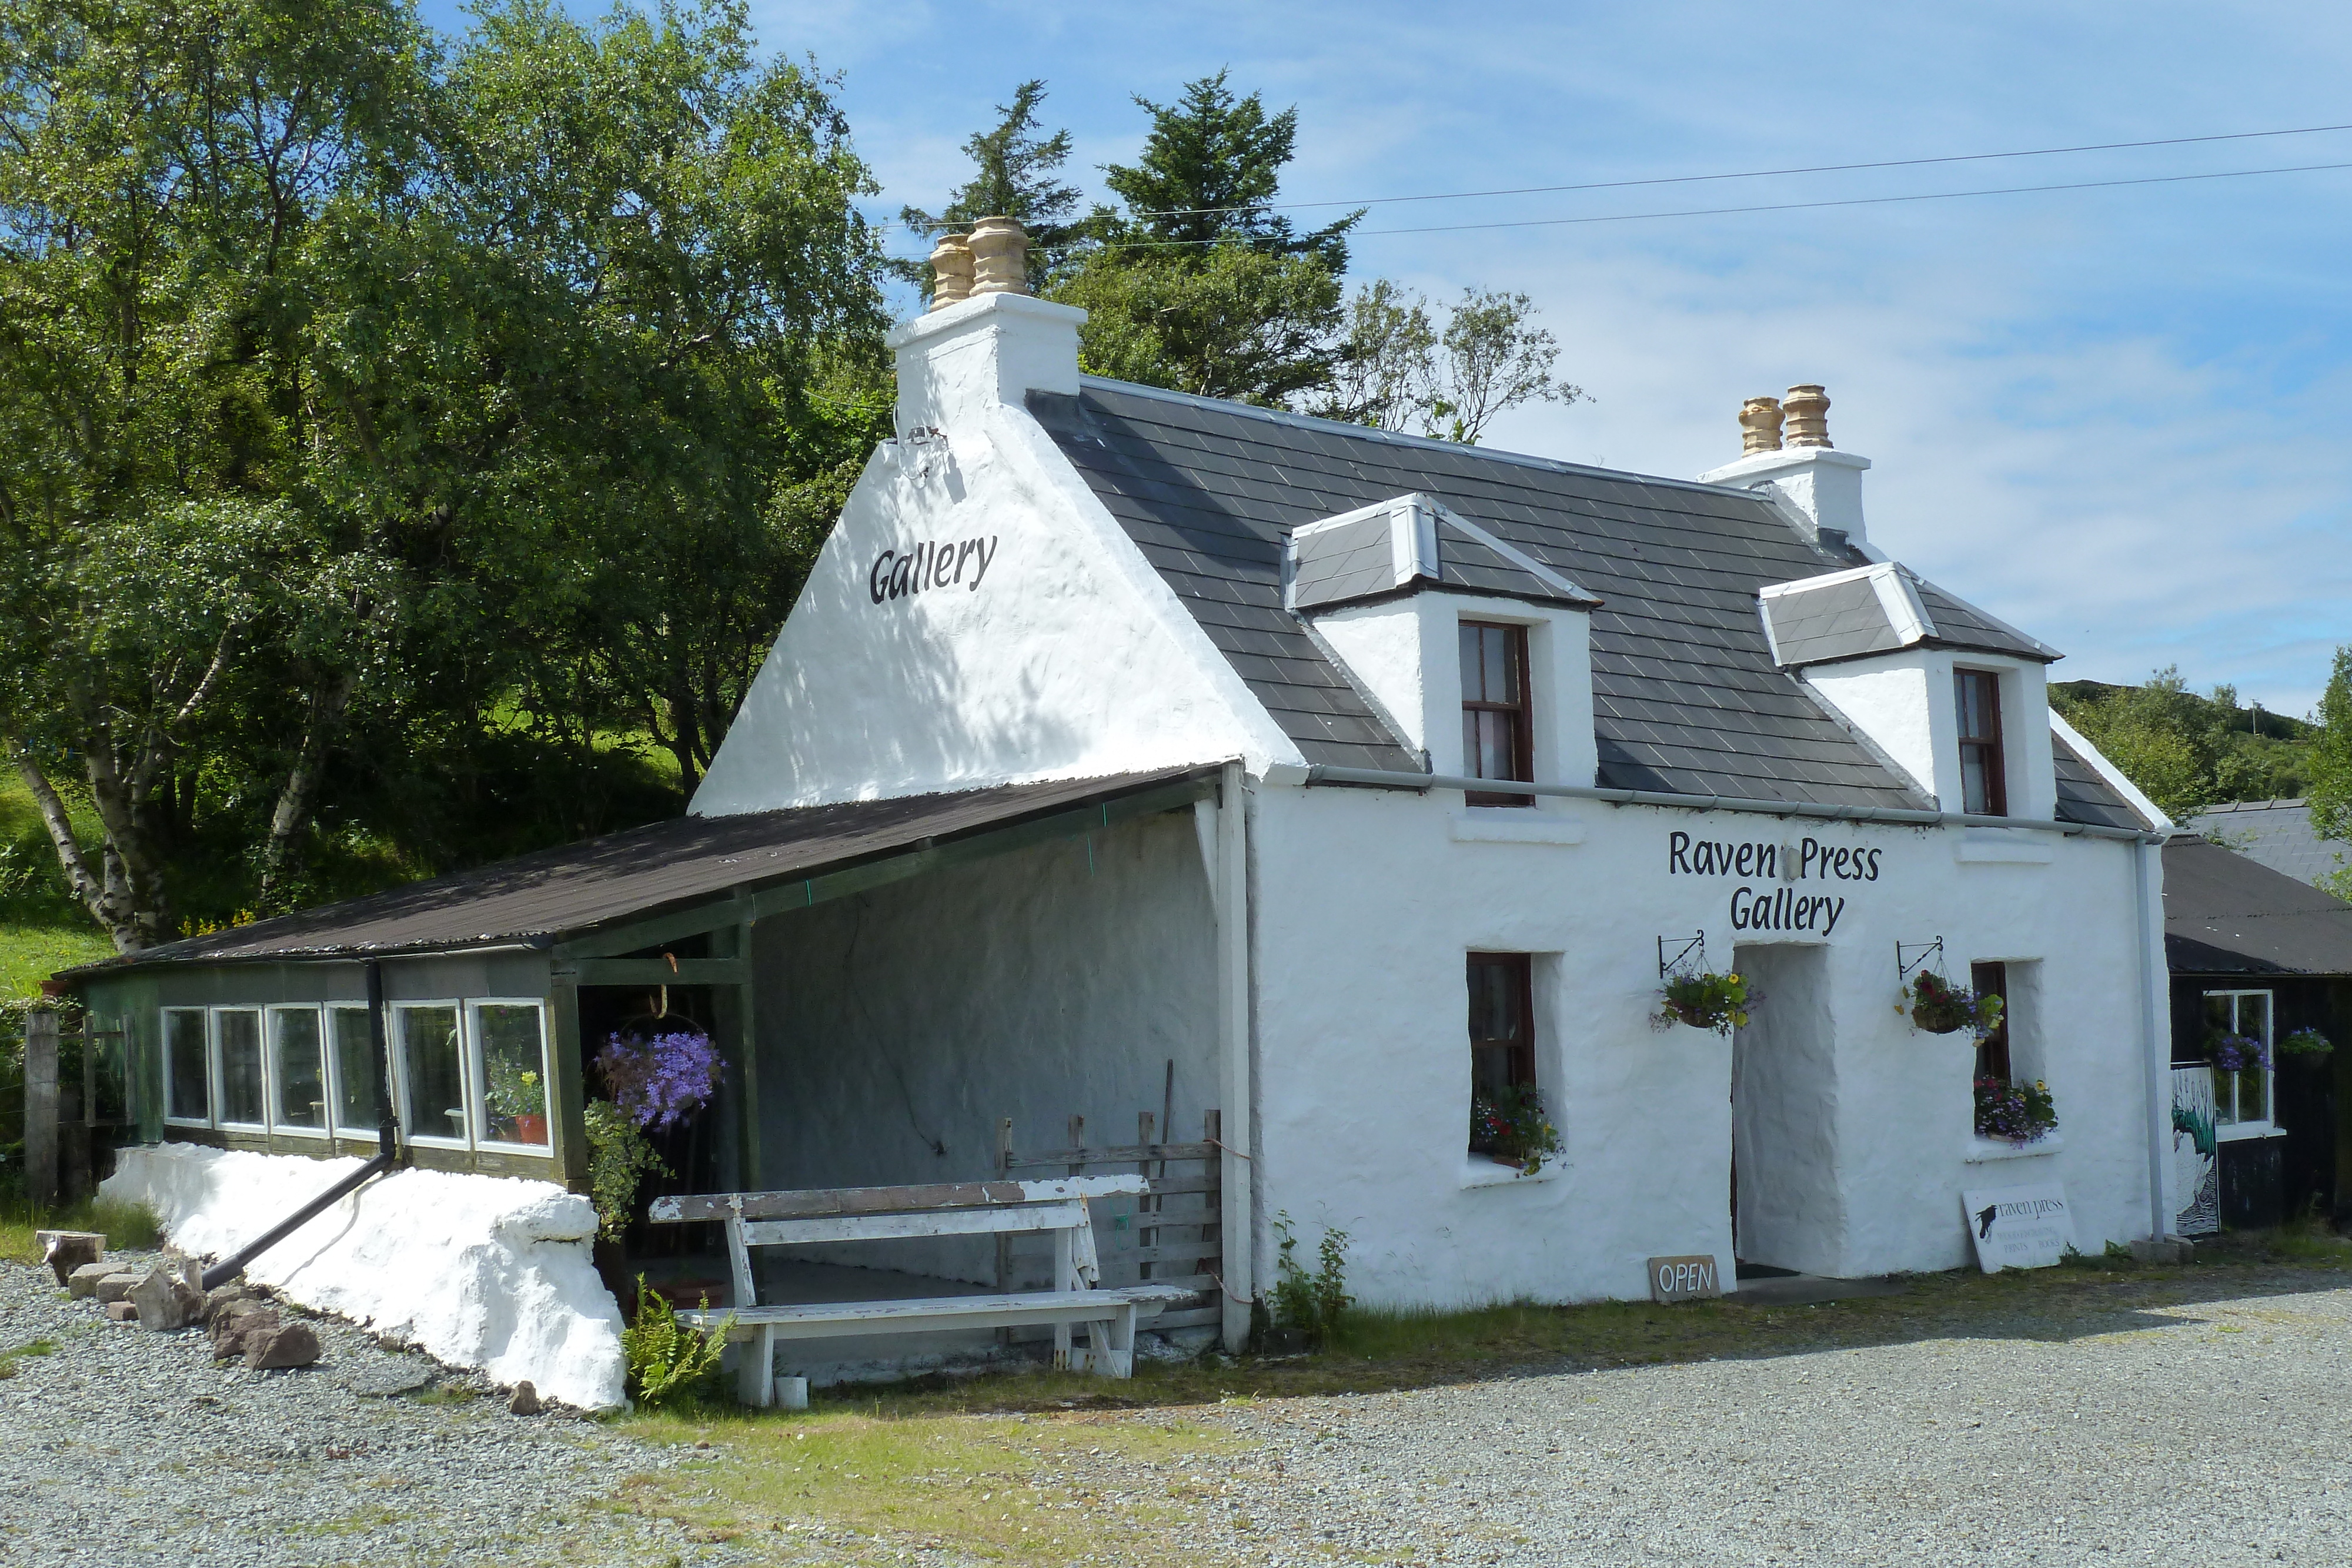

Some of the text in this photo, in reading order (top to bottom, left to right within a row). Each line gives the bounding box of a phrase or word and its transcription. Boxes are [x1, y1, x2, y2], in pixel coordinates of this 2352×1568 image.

[870, 536, 998, 605] Gallery
[1669, 831, 1883, 881] Raven Press
[1730, 886, 1845, 937] Gallery
[1999, 1198, 2064, 1220] raven press
[1658, 1262, 1713, 1293] OPEN
